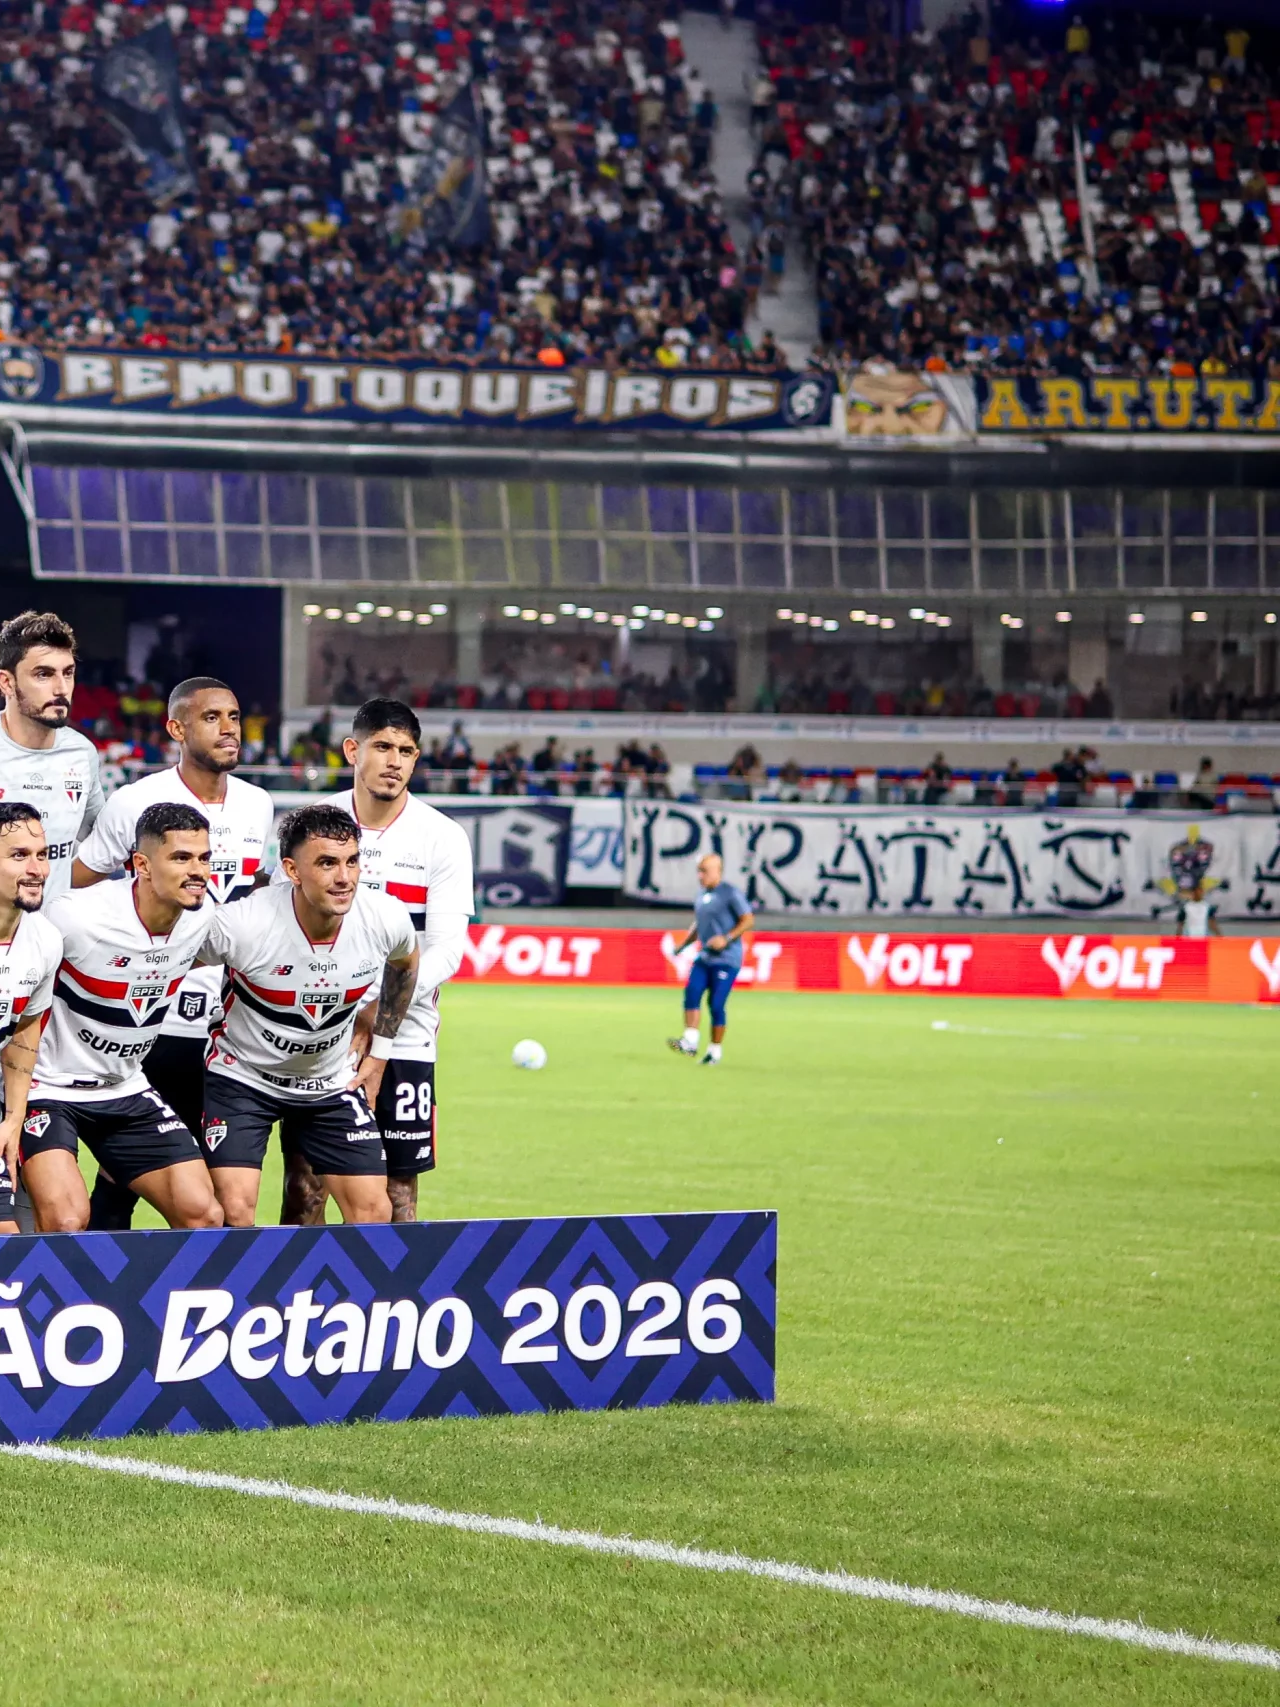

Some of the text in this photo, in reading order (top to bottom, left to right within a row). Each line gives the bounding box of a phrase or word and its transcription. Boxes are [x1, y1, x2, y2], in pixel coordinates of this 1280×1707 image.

[63, 352, 780, 420] REMOTOQUEIROS
[22, 784, 53, 792] ADEMICON
[64, 781, 83, 790] SPFC
[48, 841, 73, 860] BET
[210, 860, 237, 871] SPFC
[144, 954, 169, 965] elgin
[661, 930, 782, 983] VLT
[847, 934, 973, 988] VOLT
[1040, 934, 1175, 990] VOLT
[308, 962, 337, 974] elgin
[134, 987, 163, 997] SPFC
[304, 994, 338, 1003] SPFC
[395, 1082, 431, 1121] 28
[155, 1289, 474, 1384] Betano
[502, 1278, 742, 1365] 2026
